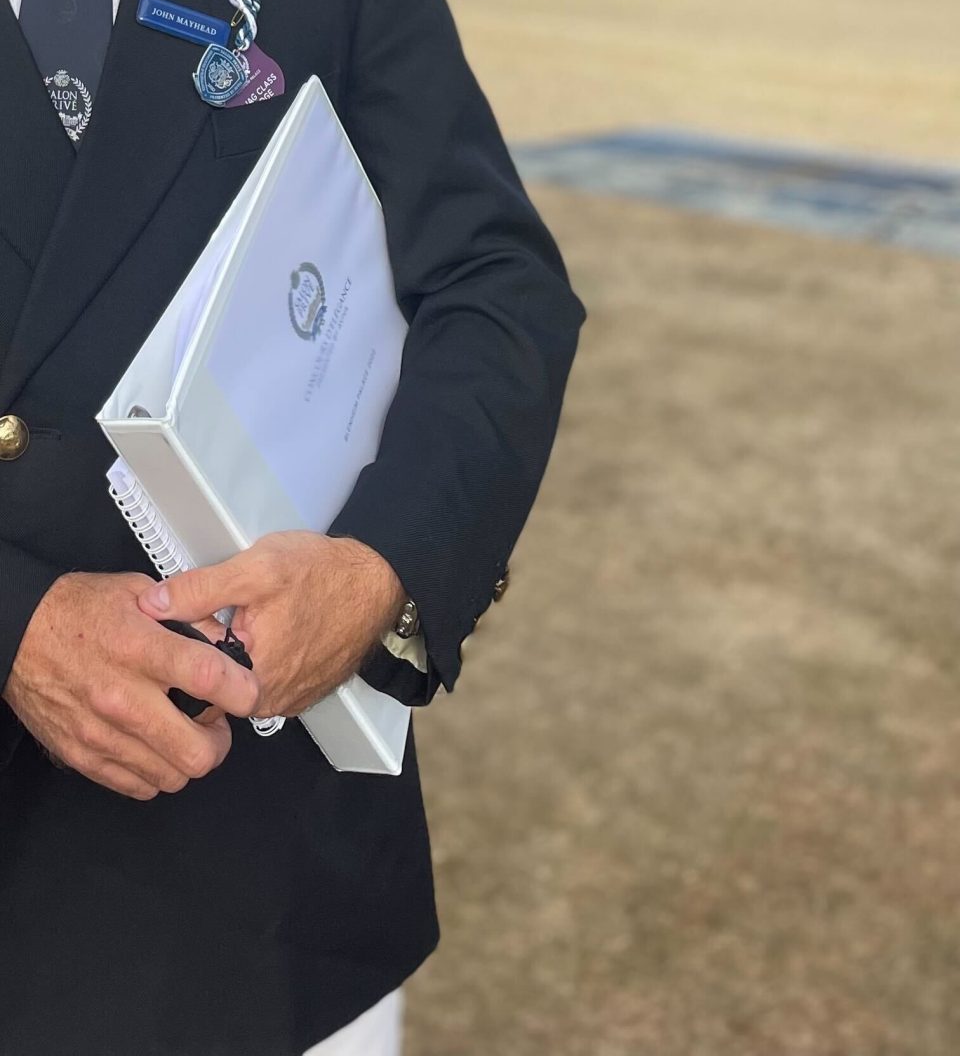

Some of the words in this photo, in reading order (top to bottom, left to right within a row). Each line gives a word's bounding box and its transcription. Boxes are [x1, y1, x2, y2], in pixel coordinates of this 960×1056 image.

[152, 7, 175, 21] JOHN
[176, 17, 217, 36] MAYHEAD
[256, 73, 277, 95] CLASS
[47, 90, 78, 101] ALON
